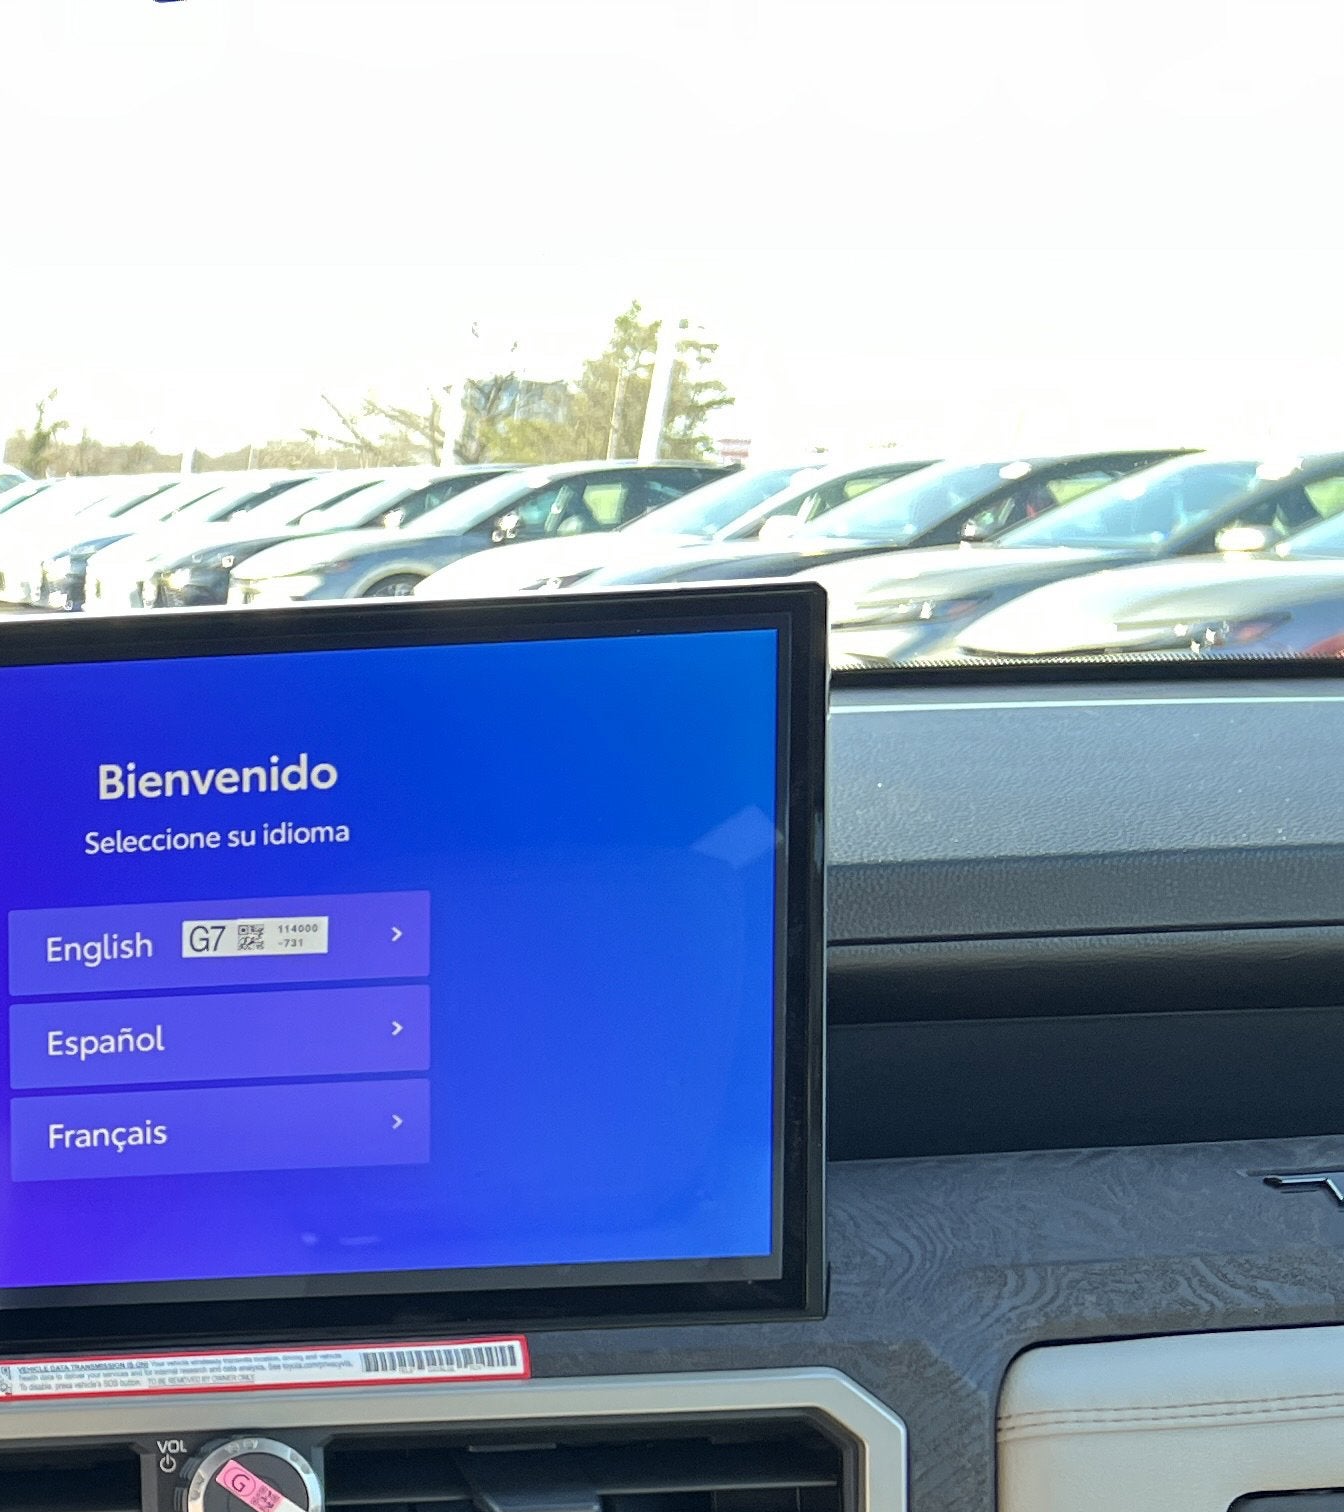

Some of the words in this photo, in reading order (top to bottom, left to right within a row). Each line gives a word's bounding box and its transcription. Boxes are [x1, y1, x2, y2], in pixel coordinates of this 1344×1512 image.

[98, 752, 339, 801] Bienvenido
[84, 827, 222, 856] Seleccione
[227, 826, 257, 848] su
[262, 821, 351, 847] idioma
[189, 925, 227, 953] G7
[277, 924, 319, 934] 114000
[46, 932, 154, 968] English
[46, 1025, 166, 1061] Español
[48, 1119, 168, 1153] Français
[156, 1439, 188, 1454] VOL
[230, 1473, 251, 1494] G
